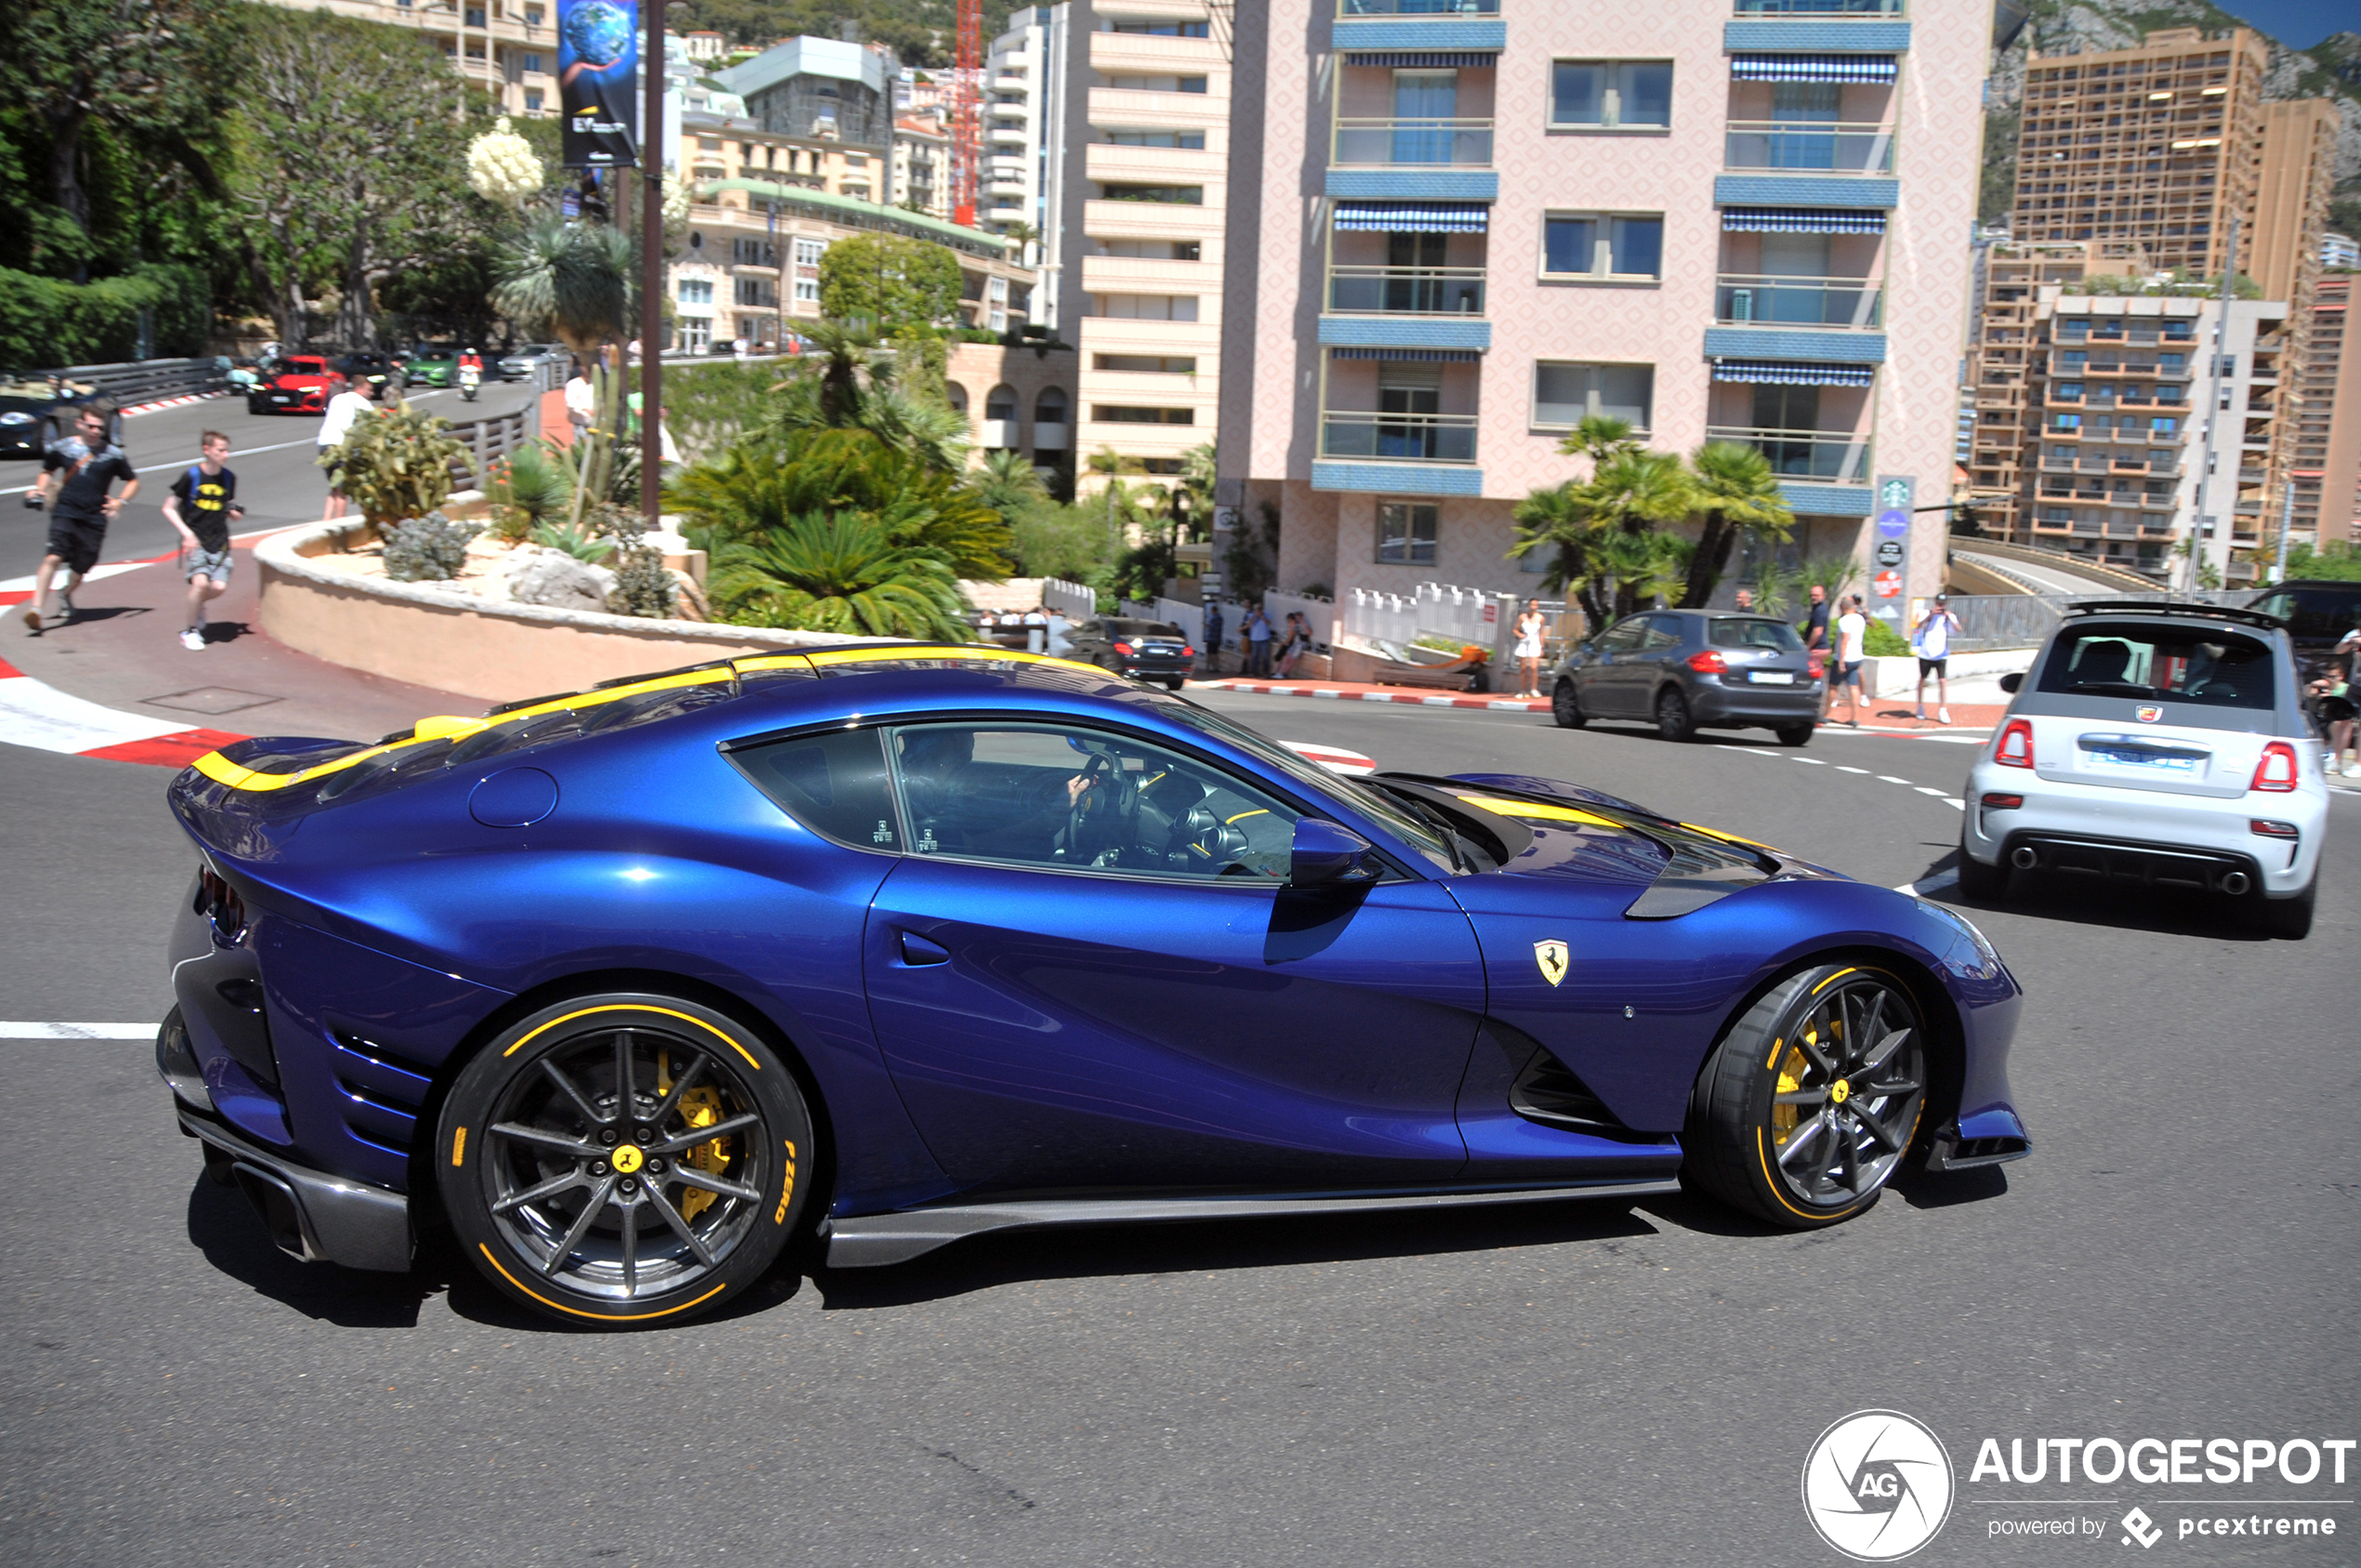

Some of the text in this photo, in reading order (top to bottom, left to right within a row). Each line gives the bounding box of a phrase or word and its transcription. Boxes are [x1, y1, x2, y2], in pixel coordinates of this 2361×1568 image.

[573, 117, 595, 133] EY
[774, 1140, 797, 1225] P ZERO
